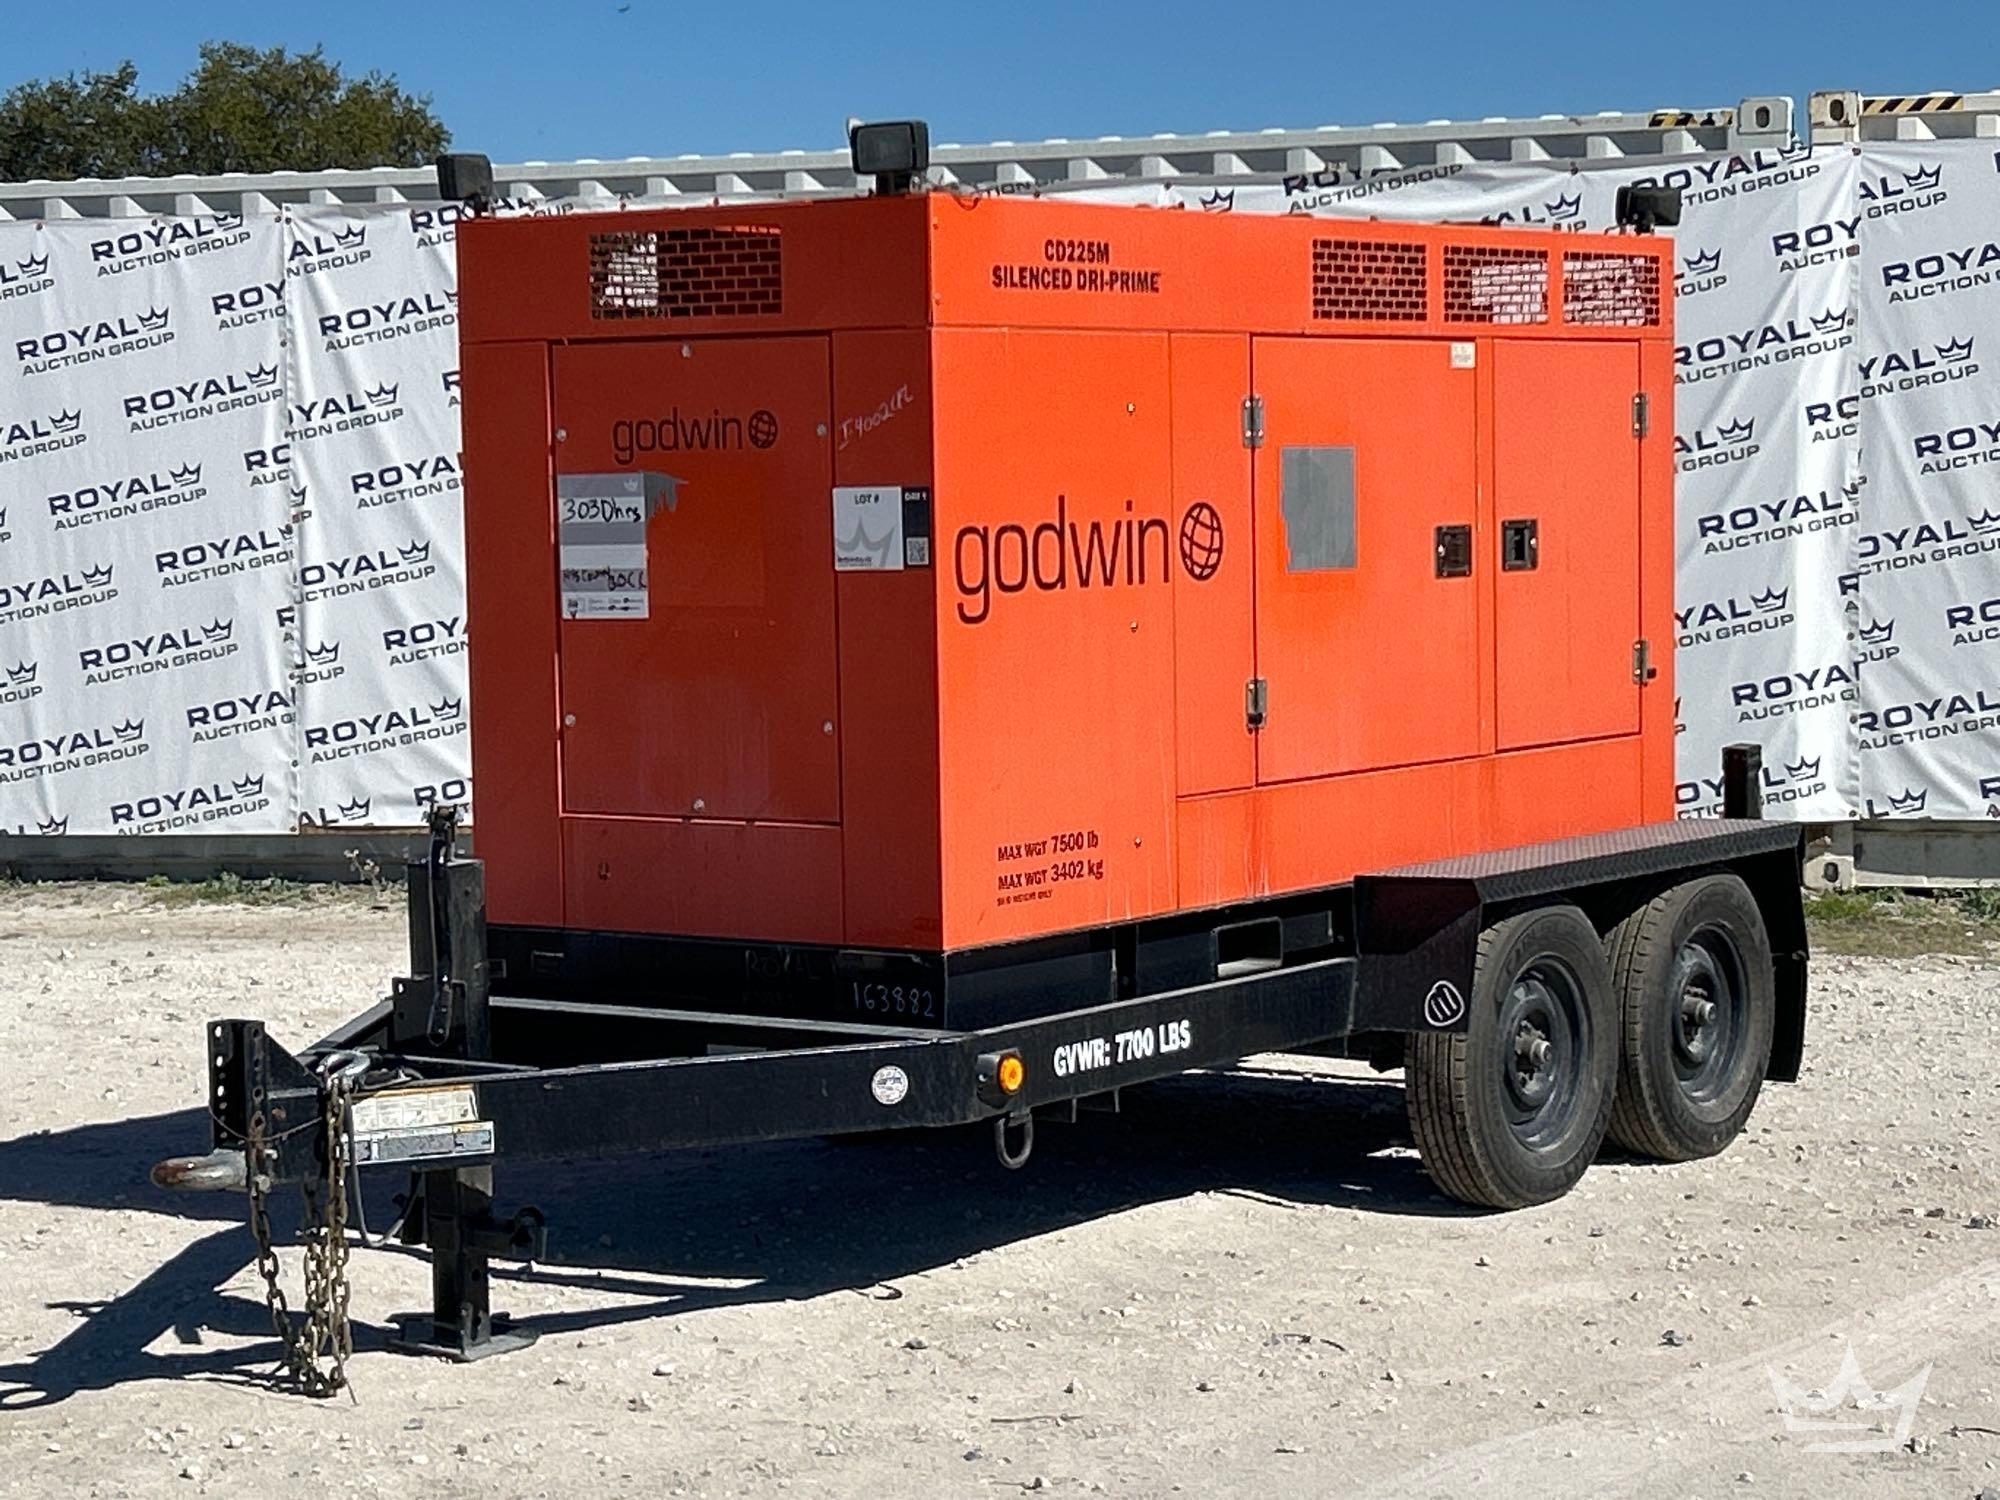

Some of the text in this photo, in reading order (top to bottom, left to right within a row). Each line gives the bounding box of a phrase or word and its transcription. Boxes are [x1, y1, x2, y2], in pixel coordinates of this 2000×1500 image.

[1289, 182, 1383, 213] AUCTION
[1387, 163, 1463, 190] GROUP
[1684, 165, 1820, 207] TION GROUP
[1866, 191, 1948, 219] GROUP
[90, 218, 214, 262] ROYAL
[1045, 239, 1109, 264] CD225M
[1772, 215, 1861, 256] ROY
[97, 231, 251, 277] AUCTION GROUP
[303, 250, 371, 275] GROUP
[1779, 244, 1860, 273] AUCTIO
[1882, 243, 2000, 287] ROYA
[0, 279, 55, 300] ROUP
[212, 278, 286, 315] ROY
[992, 265, 1161, 293] SILENCED DRI-PRIME
[1674, 275, 1728, 298] OUP
[1889, 272, 1990, 304] AUCTION
[218, 304, 287, 331] AUCTIO
[319, 293, 446, 336] ROYAL
[325, 313, 455, 352] AUCTION GRO
[16, 317, 139, 361] ROYAL
[23, 331, 175, 377] AUCTION GROUP
[1775, 335, 1853, 363] GROUP
[1858, 349, 1936, 381] YAL
[1899, 364, 1979, 391] GROUP
[124, 375, 248, 418] ROYAL
[130, 388, 284, 433] AUCTION GROUP
[288, 394, 366, 425] YAL
[285, 408, 403, 442] TION GROUP
[613, 406, 743, 465] godwin
[1914, 421, 2000, 458] ROY
[22, 433, 87, 458] GROUP
[1681, 444, 1760, 473] GROUP
[351, 456, 455, 494] ROYA
[48, 473, 171, 515] ROYAL
[55, 487, 207, 531] AUCTION GROUP
[357, 481, 443, 509] AUCTION
[1698, 490, 1843, 538] ROYAL
[1704, 511, 1860, 555] AUCTION GRO
[1858, 520, 1968, 558] OYAL
[155, 530, 279, 573] ROYAL
[161, 549, 295, 588] AUCTION GRO
[301, 551, 399, 587] OYAL
[955, 495, 1169, 624] godwin
[1858, 537, 2000, 576] CTION GROU
[369, 565, 436, 589] GROUP
[53, 589, 118, 612] GROUP
[1674, 598, 1752, 631] YAL
[383, 616, 465, 651] ROY
[1716, 613, 1795, 640] GROUP
[79, 628, 202, 671] ROYAL
[85, 643, 239, 686] AUCTION GROUP
[0, 686, 43, 703] OUP
[1738, 692, 1835, 723] AUCTION
[193, 714, 277, 743] AUCTION
[305, 707, 431, 749] ROYAL
[311, 721, 467, 764] AUCTION GROUP
[1858, 723, 1958, 751] AUCTION
[84, 743, 150, 767] GROUP
[110, 784, 233, 825] ROYAL
[203, 797, 270, 822] GROUP
[1760, 782, 1827, 807] ROUP
[998, 830, 1099, 861] MAX WGT 7500 lb
[998, 859, 1104, 890] MAX WGT 3402 kg
[853, 982, 936, 1018] 163882
[1053, 1019, 1191, 1076] GVWR: 7700 LBS
